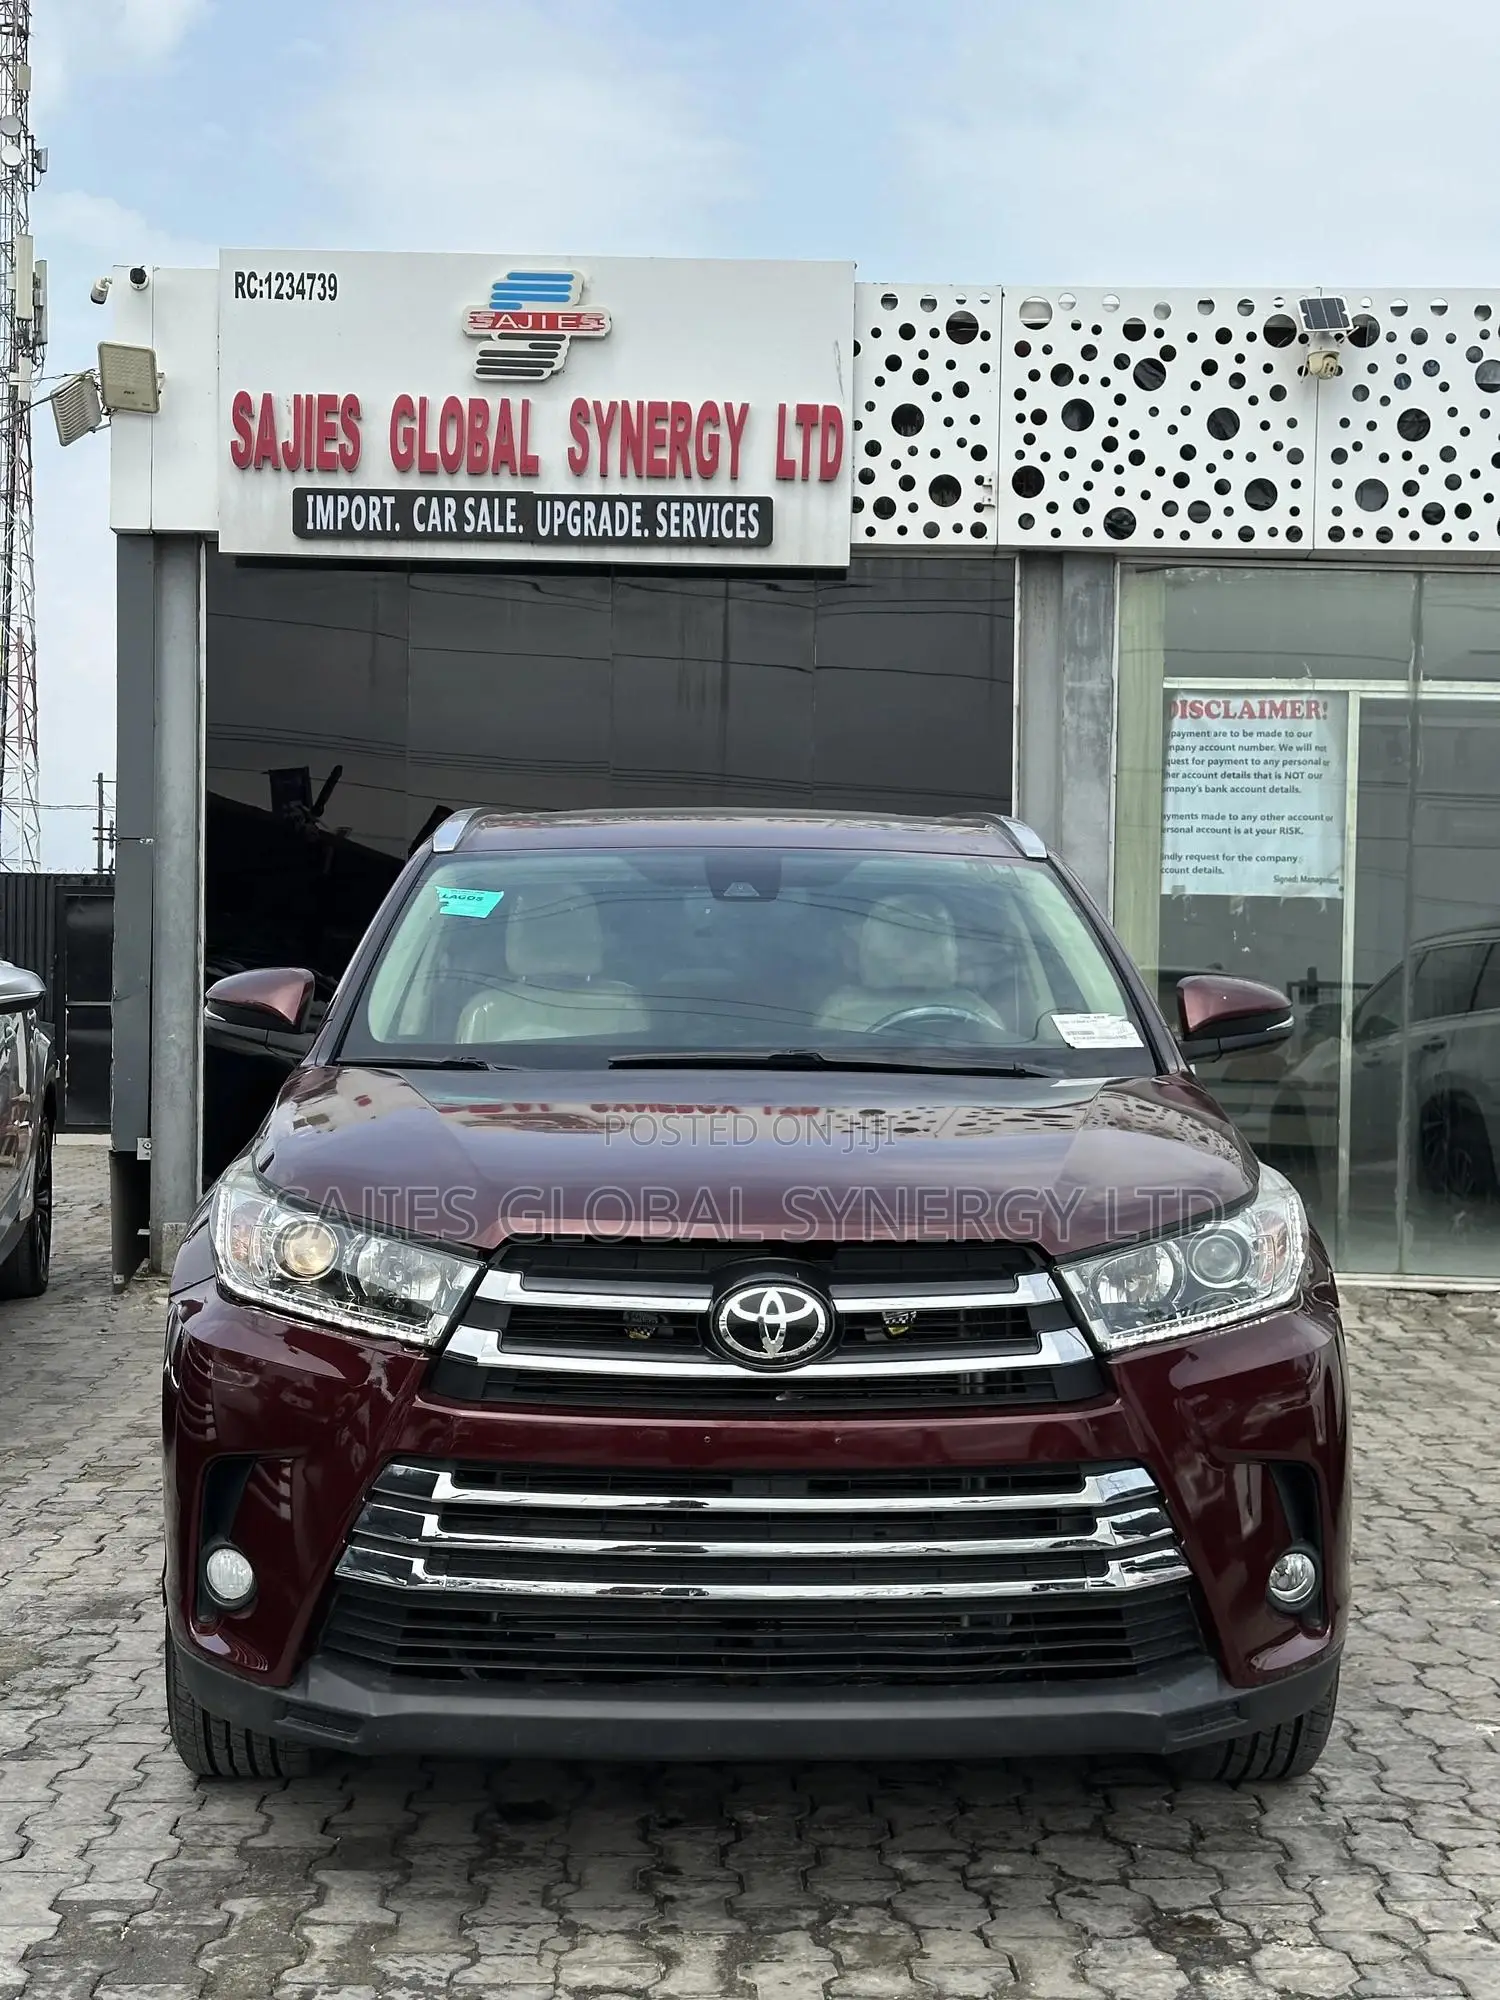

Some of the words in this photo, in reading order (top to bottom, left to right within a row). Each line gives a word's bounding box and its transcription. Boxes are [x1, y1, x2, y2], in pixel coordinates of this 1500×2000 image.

[234, 271, 339, 302] RC:1234739
[468, 311, 605, 332] SAJIES
[230, 390, 361, 473] SAJIES
[390, 394, 539, 476] GLOBAL
[568, 397, 750, 480] SYNERGY
[776, 403, 844, 482] LTD
[305, 495, 400, 532] IMPORT.
[413, 497, 461, 533] CAR
[463, 497, 524, 535] SALE.
[537, 500, 650, 538] UPGRADE.
[656, 502, 760, 540] SERVICES
[1171, 731, 1210, 740] payment
[1230, 730, 1240, 738] to
[1243, 729, 1254, 738] be
[1257, 729, 1282, 738] made
[1285, 730, 1295, 738] to
[1199, 744, 1236, 752] account
[1279, 743, 1293, 752] We
[1296, 743, 1312, 752] will
[1192, 756, 1205, 765] for
[1207, 758, 1248, 767] payment
[1251, 757, 1261, 766] to
[1263, 759, 1280, 768] any
[1282, 757, 1321, 767] personal
[1182, 771, 1218, 779] account
[1220, 770, 1251, 779] details
[1253, 771, 1272, 779] that
[1275, 771, 1282, 779] is
[1284, 771, 1305, 780] NOT
[1205, 785, 1228, 793] bank
[1230, 785, 1266, 793] account
[1201, 812, 1226, 821] made
[1229, 813, 1239, 821] to
[1241, 814, 1258, 823] any
[1260, 812, 1285, 821] other
[1287, 813, 1324, 821] account
[1243, 827, 1253, 835] at
[1255, 828, 1277, 836] your
[1185, 853, 1219, 862] request
[1222, 852, 1235, 861] for
[1237, 853, 1253, 862] the
